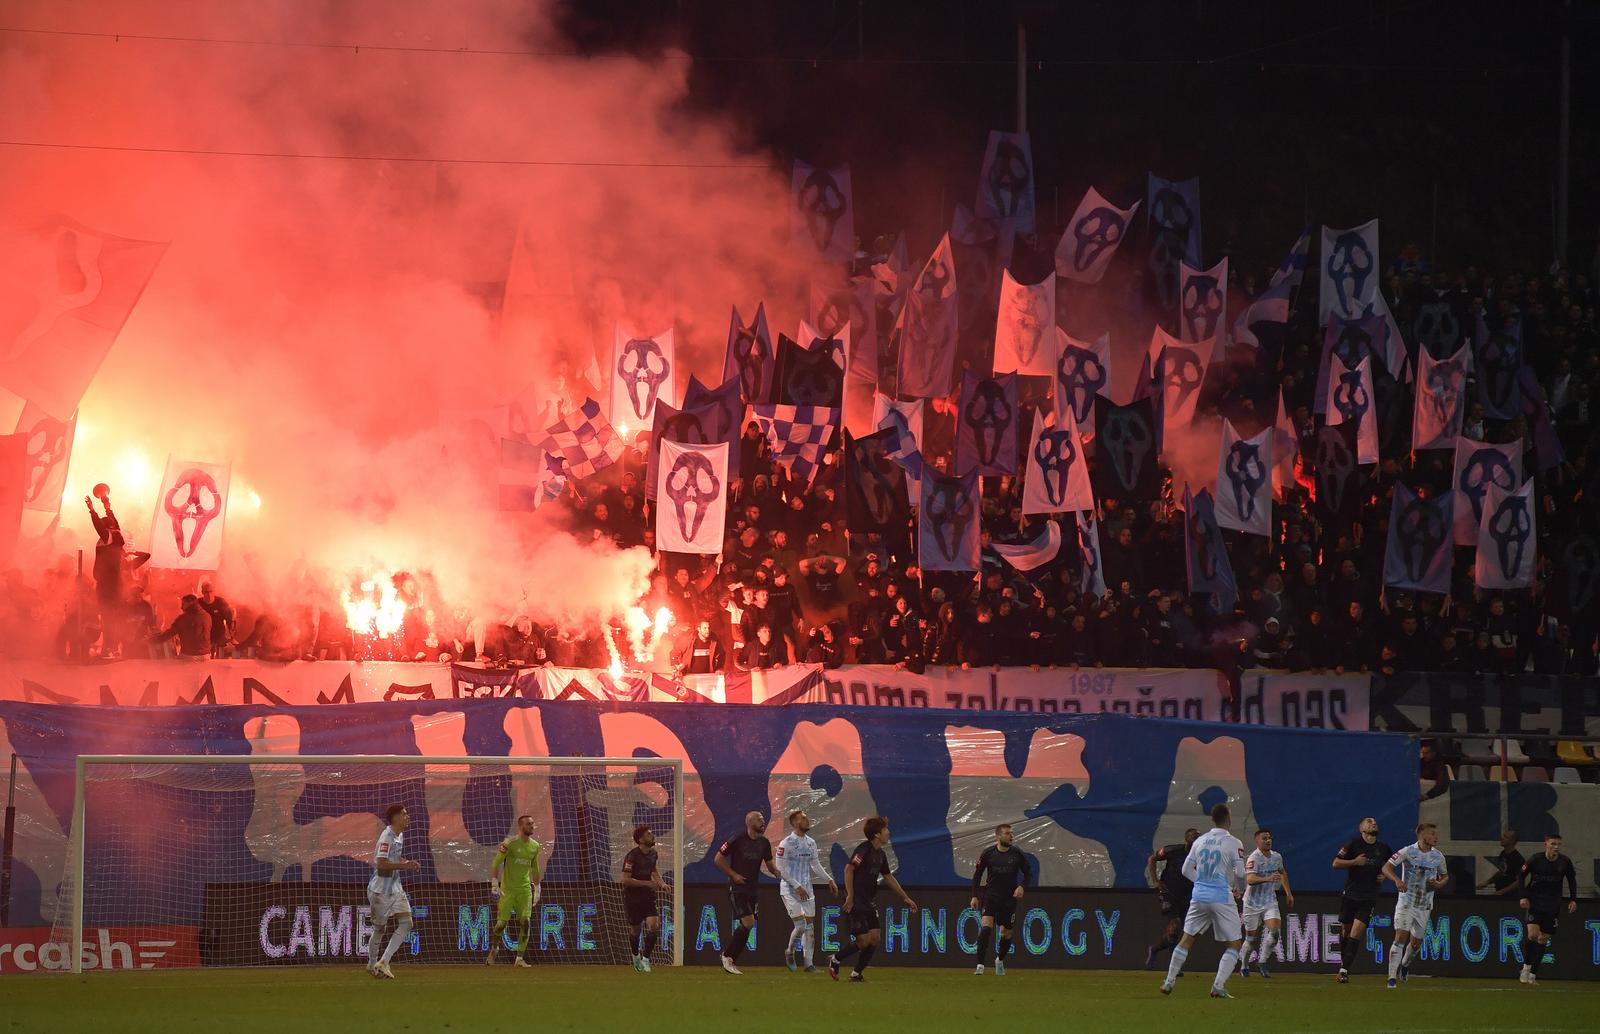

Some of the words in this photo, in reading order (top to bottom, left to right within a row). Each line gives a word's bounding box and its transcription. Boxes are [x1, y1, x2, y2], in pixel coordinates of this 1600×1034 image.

[1069, 674, 1116, 695] 1987
[258, 905, 371, 957] CAME
[796, 906, 1120, 956] EHNOOGY
[1420, 915, 1556, 964] MOR
